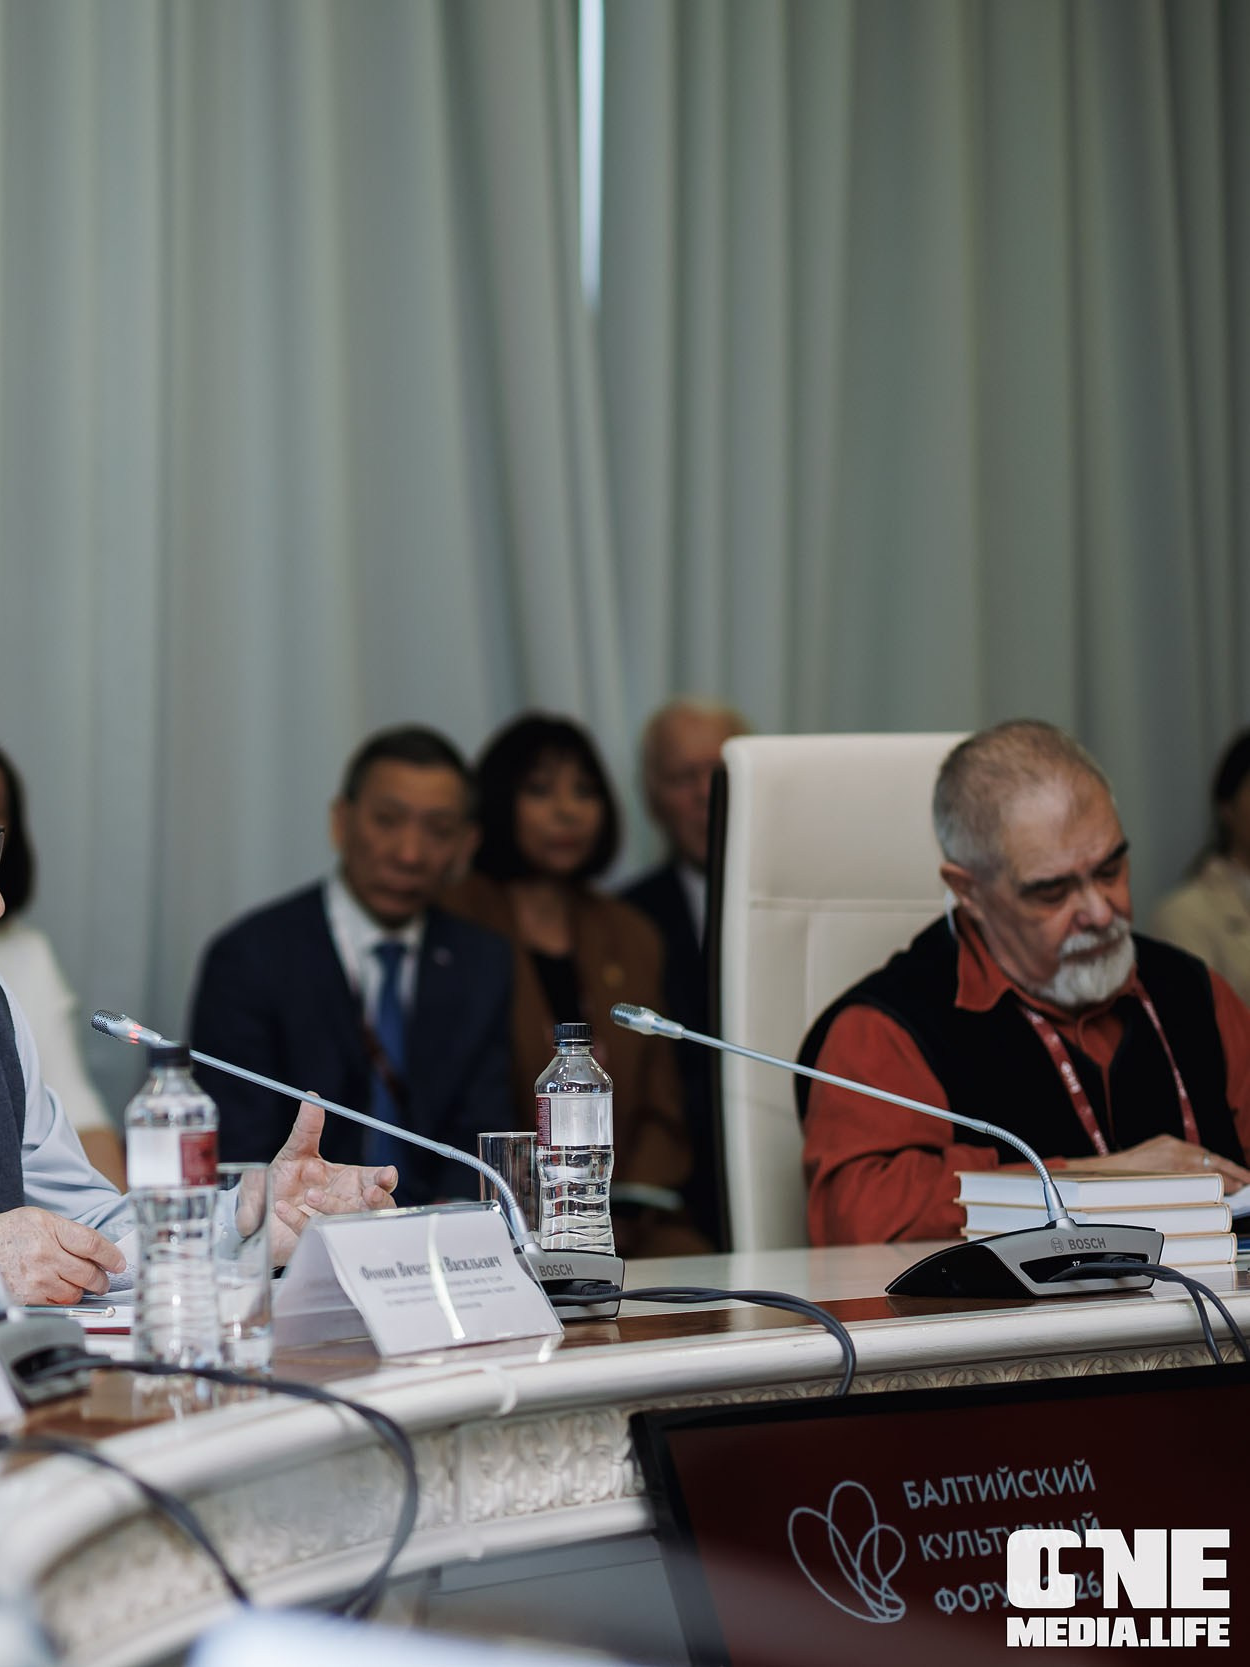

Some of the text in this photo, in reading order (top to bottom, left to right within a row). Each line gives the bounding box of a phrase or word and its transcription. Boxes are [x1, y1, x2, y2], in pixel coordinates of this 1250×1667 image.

[1067, 1237, 1107, 1251] BOSCH
[539, 1263, 575, 1277] BOSCH
[902, 1458, 1096, 1510] БАЛТИЙСКИЙ
